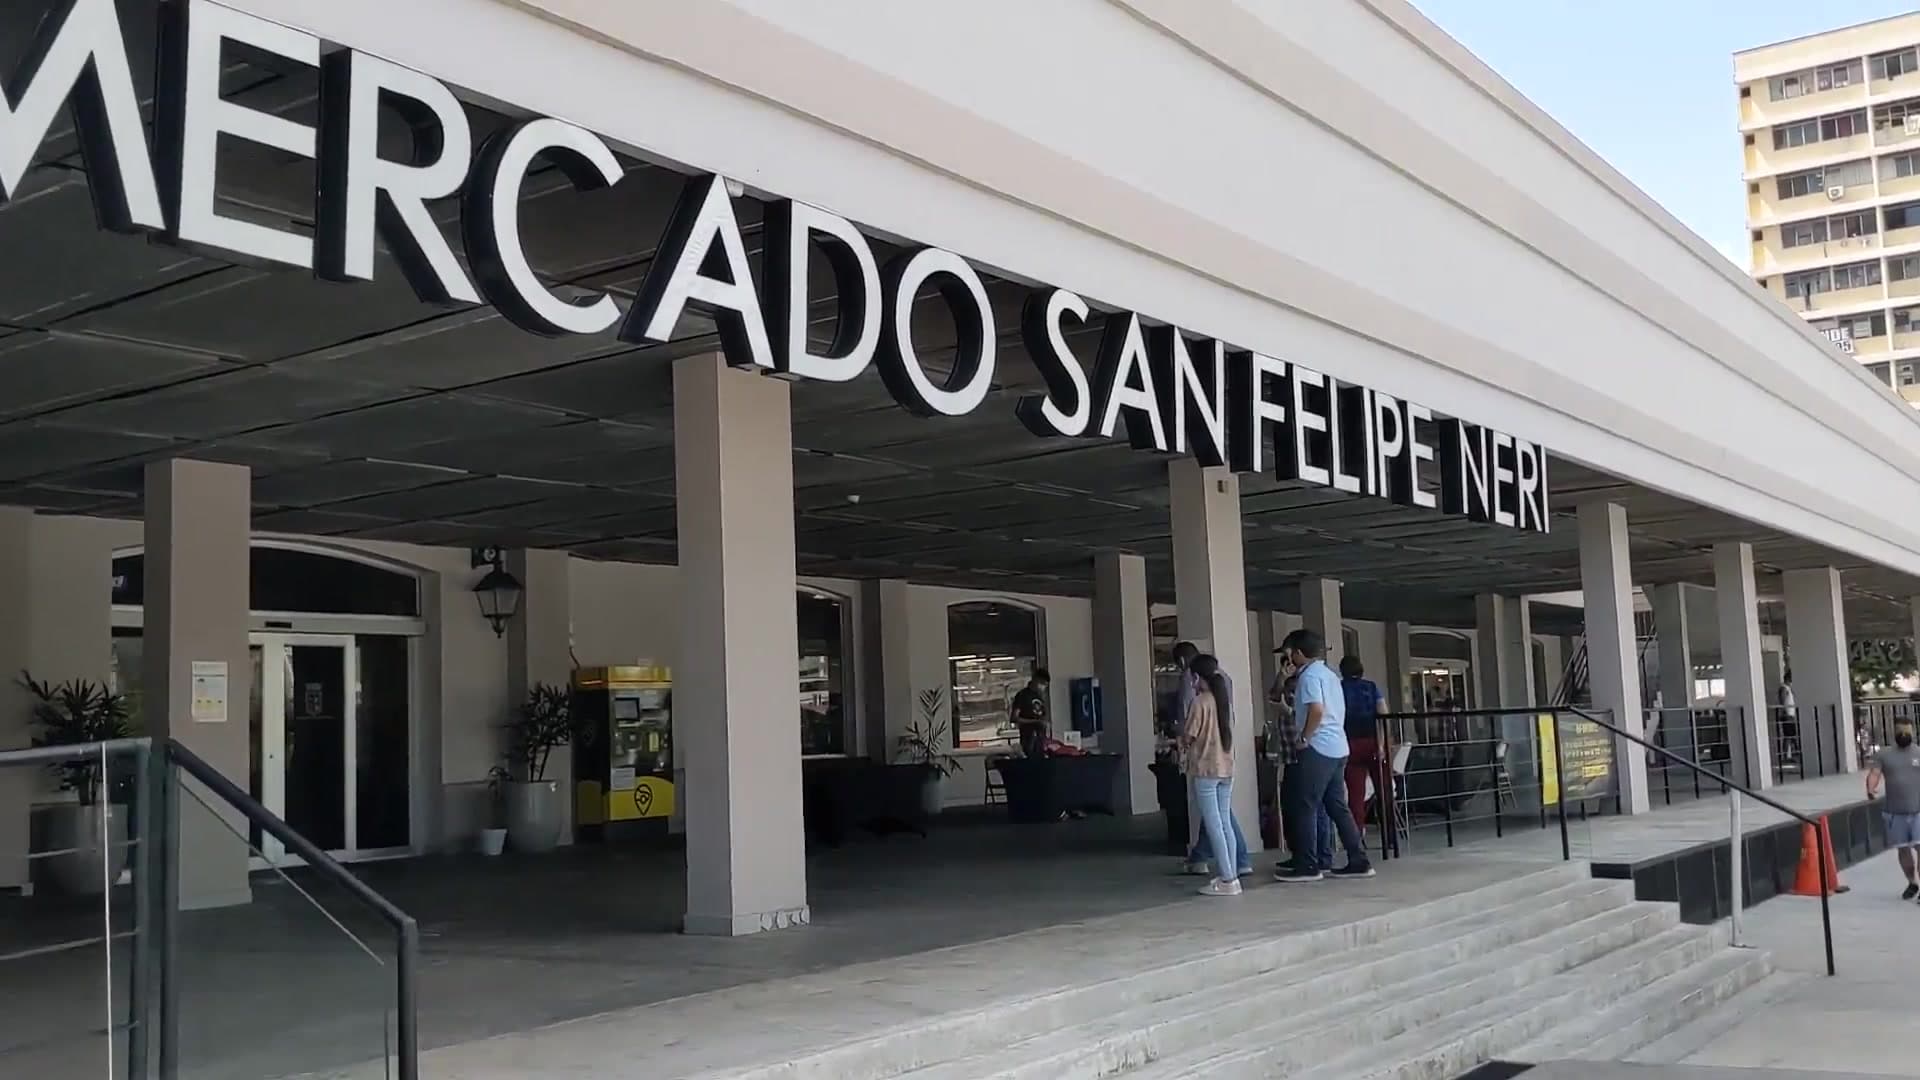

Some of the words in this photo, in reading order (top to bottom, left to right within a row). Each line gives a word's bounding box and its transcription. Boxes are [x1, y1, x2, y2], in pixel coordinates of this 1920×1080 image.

[1041, 288, 1224, 465] SAN
[1252, 352, 1437, 508] FELIPE
[1458, 419, 1550, 534] NERI
